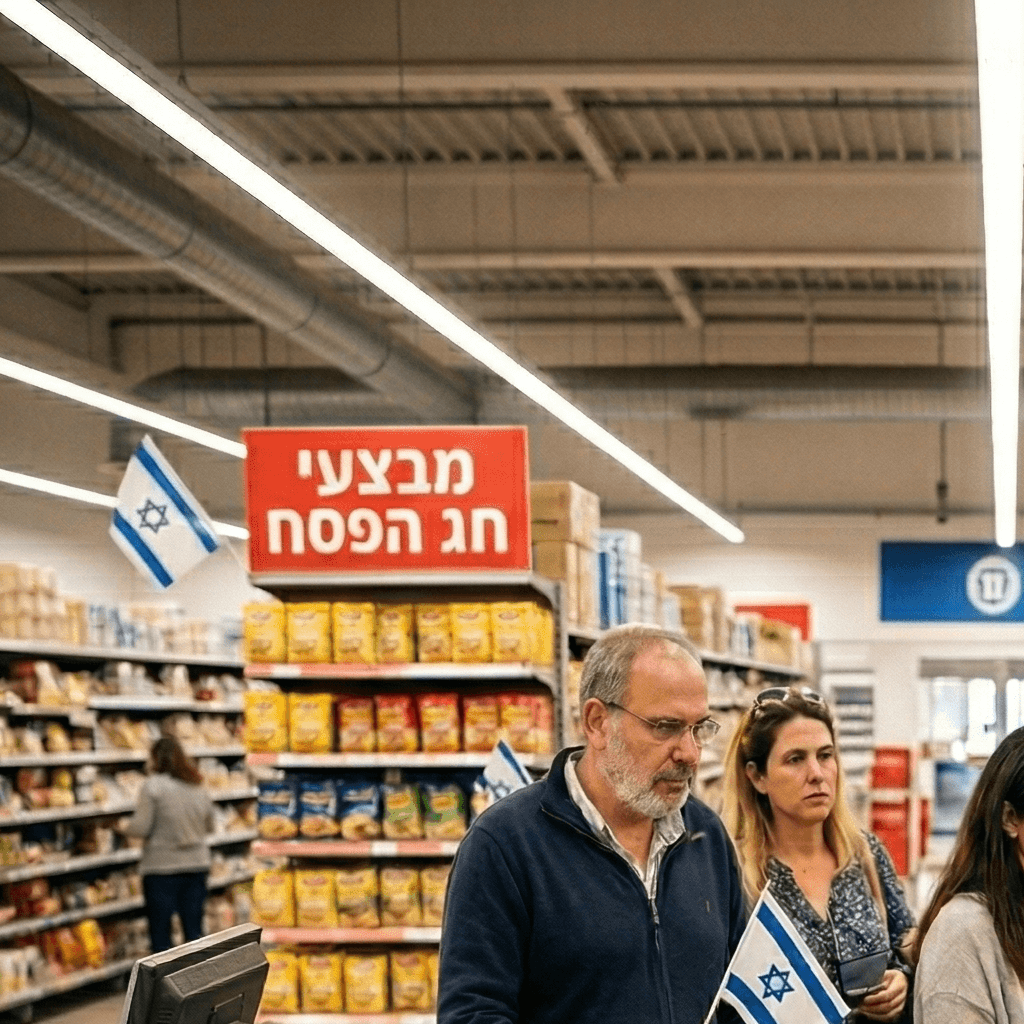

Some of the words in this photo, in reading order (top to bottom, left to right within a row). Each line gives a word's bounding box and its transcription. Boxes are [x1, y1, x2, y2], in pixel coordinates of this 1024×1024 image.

[298, 449, 475, 497] מבצעי
[267, 507, 423, 554] הפסח
[441, 507, 508, 554] חג
